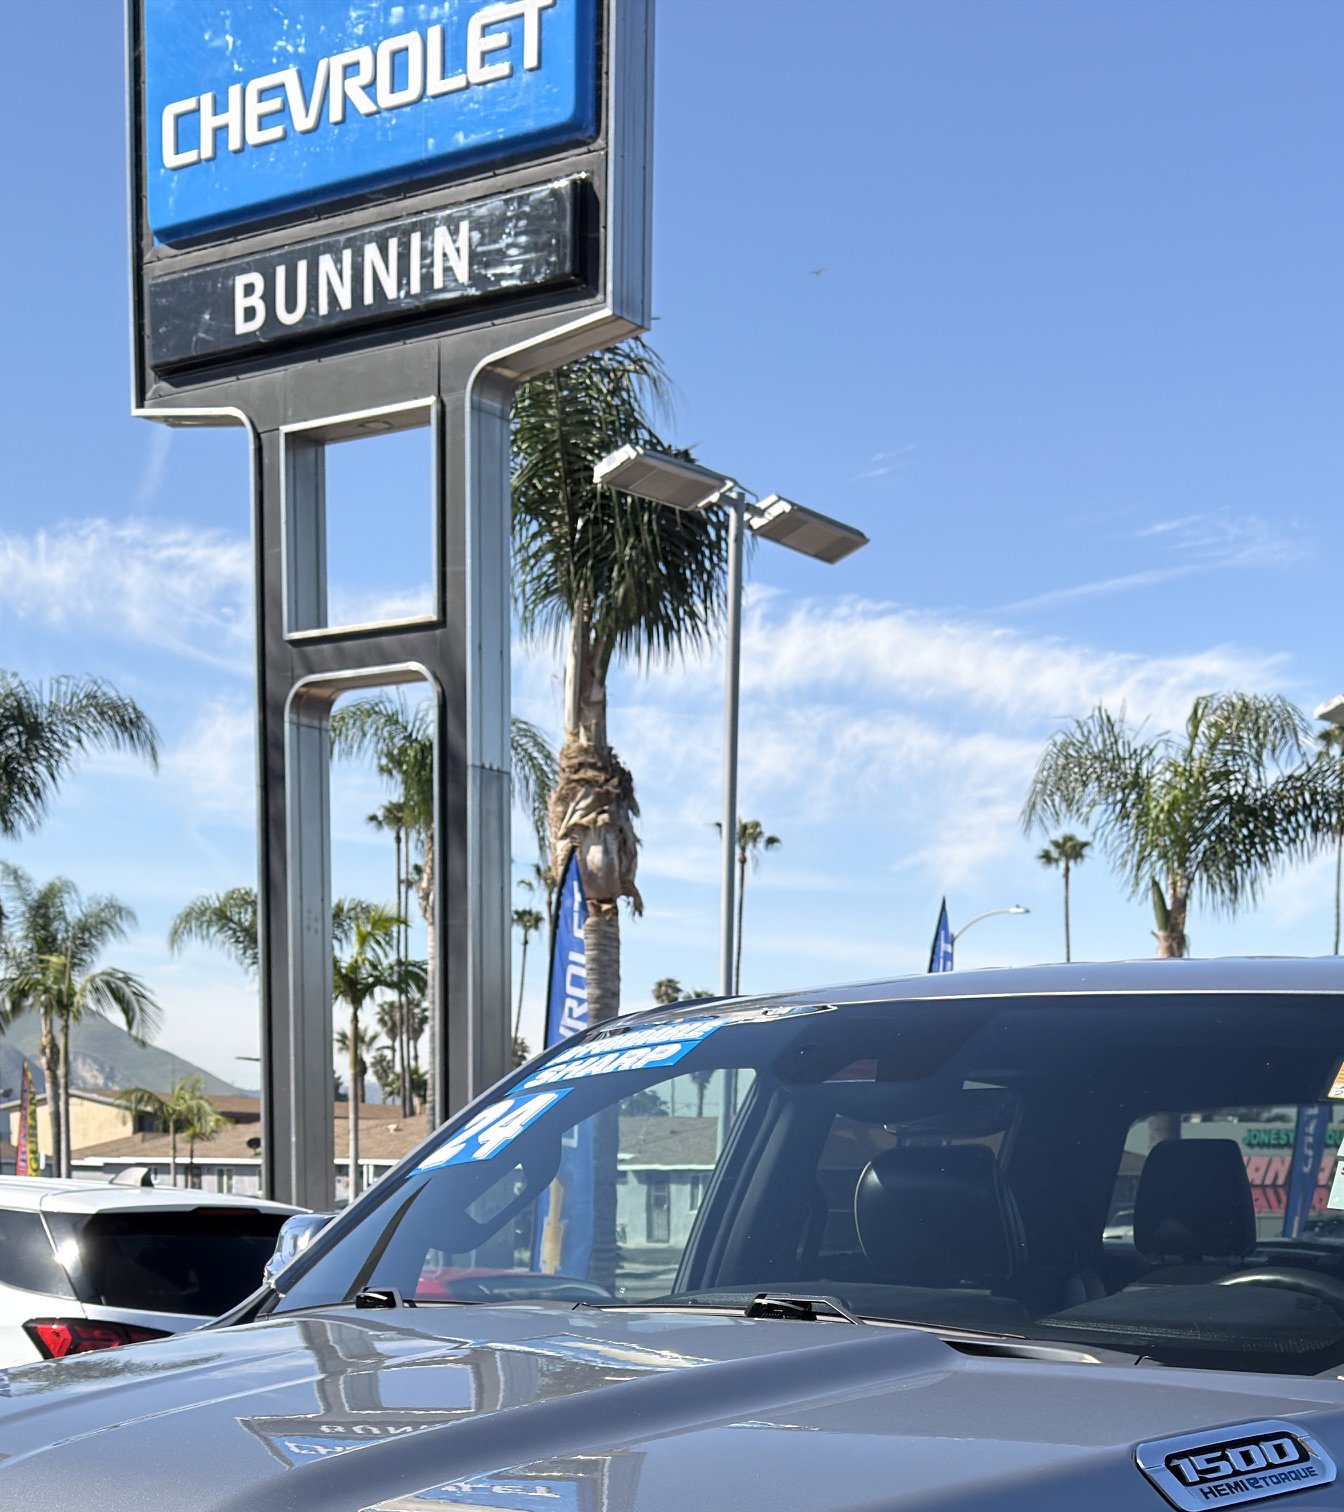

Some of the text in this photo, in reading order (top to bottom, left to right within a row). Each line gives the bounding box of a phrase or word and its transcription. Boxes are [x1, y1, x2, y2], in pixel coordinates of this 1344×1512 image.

[161, 0, 556, 170] CHEVROLET
[234, 220, 471, 336] BUNNIN
[524, 1043, 682, 1089] SHARP
[1170, 1438, 1300, 1483] 1500
[1199, 1480, 1249, 1500] HEMI
